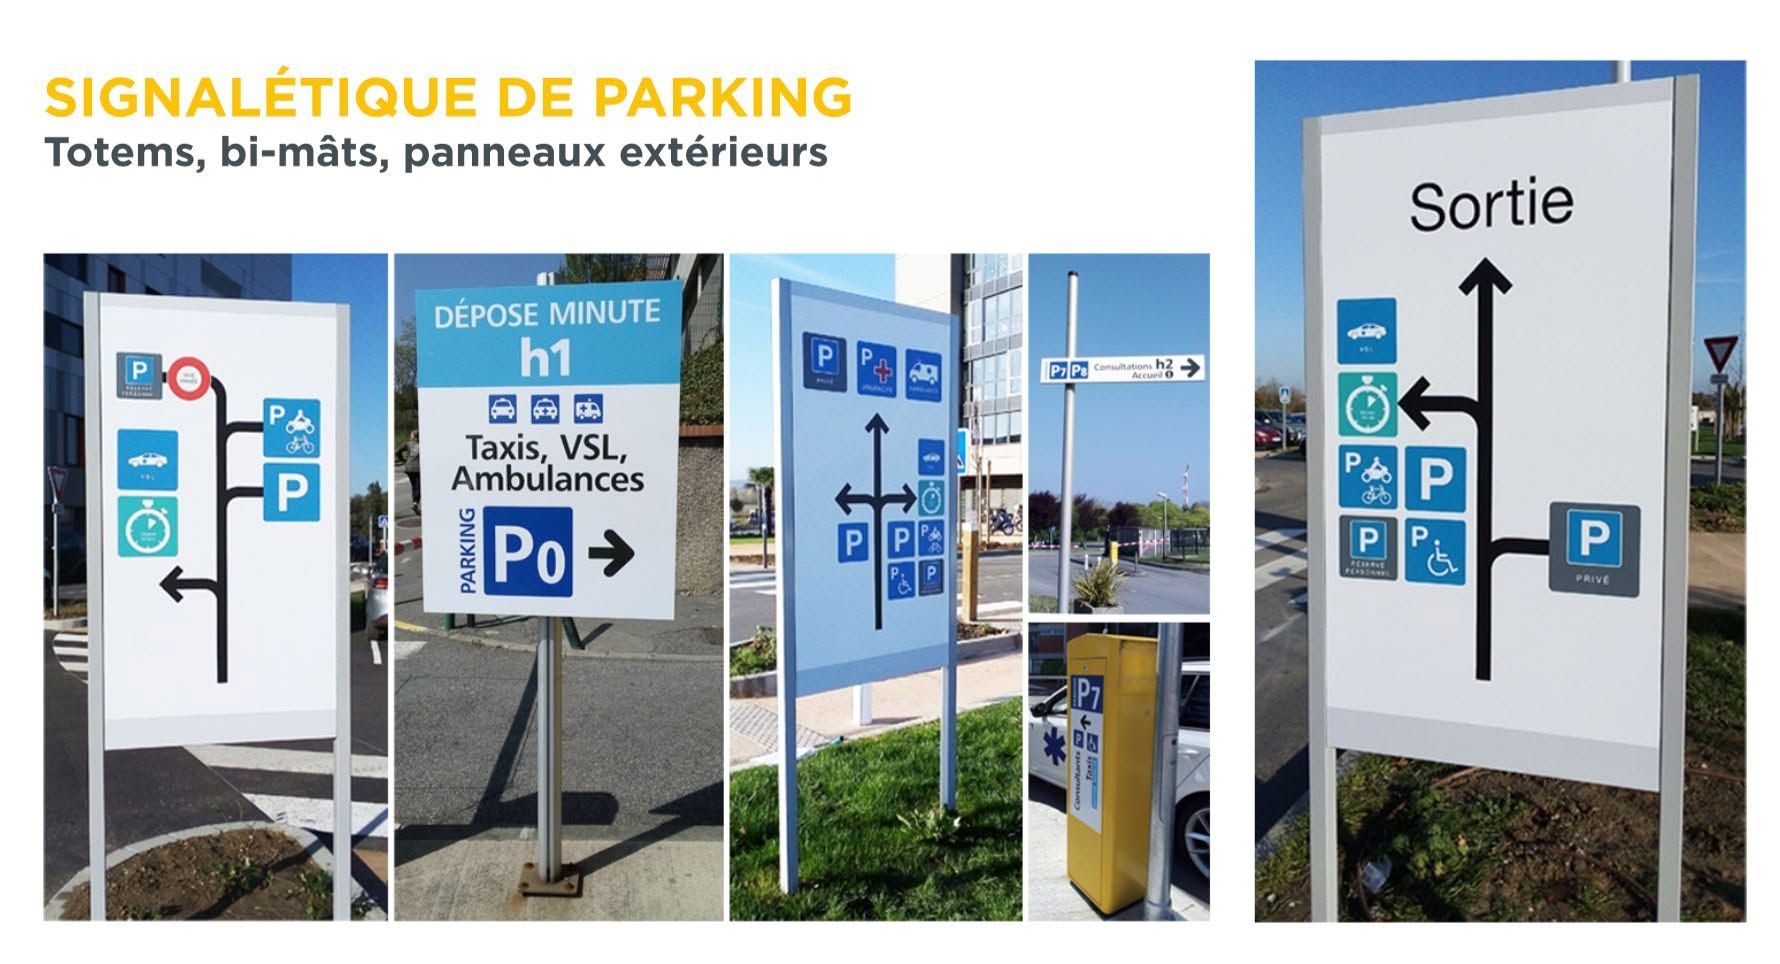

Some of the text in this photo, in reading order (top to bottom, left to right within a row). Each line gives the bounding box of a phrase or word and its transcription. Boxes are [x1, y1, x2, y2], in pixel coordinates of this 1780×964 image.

[1411, 175, 1574, 232] Sortie
[435, 298, 660, 329] DÉPOSE MINUTE
[520, 336, 570, 377] h1
[818, 344, 833, 367] P
[861, 347, 873, 366] P
[1094, 358, 1173, 372] Consultations h2
[132, 361, 148, 380] P
[1051, 364, 1066, 378] P7
[1071, 364, 1088, 378] P8
[1132, 370, 1163, 380] Accueil
[269, 404, 286, 426] P
[465, 433, 627, 464] Taxis, VSL,
[1345, 452, 1361, 473] P
[451, 464, 645, 492] Ambulances
[1421, 457, 1454, 500] P
[278, 472, 309, 512] P
[846, 529, 863, 557] P
[894, 527, 910, 553] P
[921, 524, 929, 537] P
[1359, 527, 1379, 553] P
[1411, 526, 1428, 548] P
[1580, 519, 1611, 556] P
[459, 508, 476, 594] PARKING
[494, 524, 566, 585] P0
[890, 566, 899, 580] P
[927, 565, 937, 581] P
[1078, 677, 1101, 711] P7
